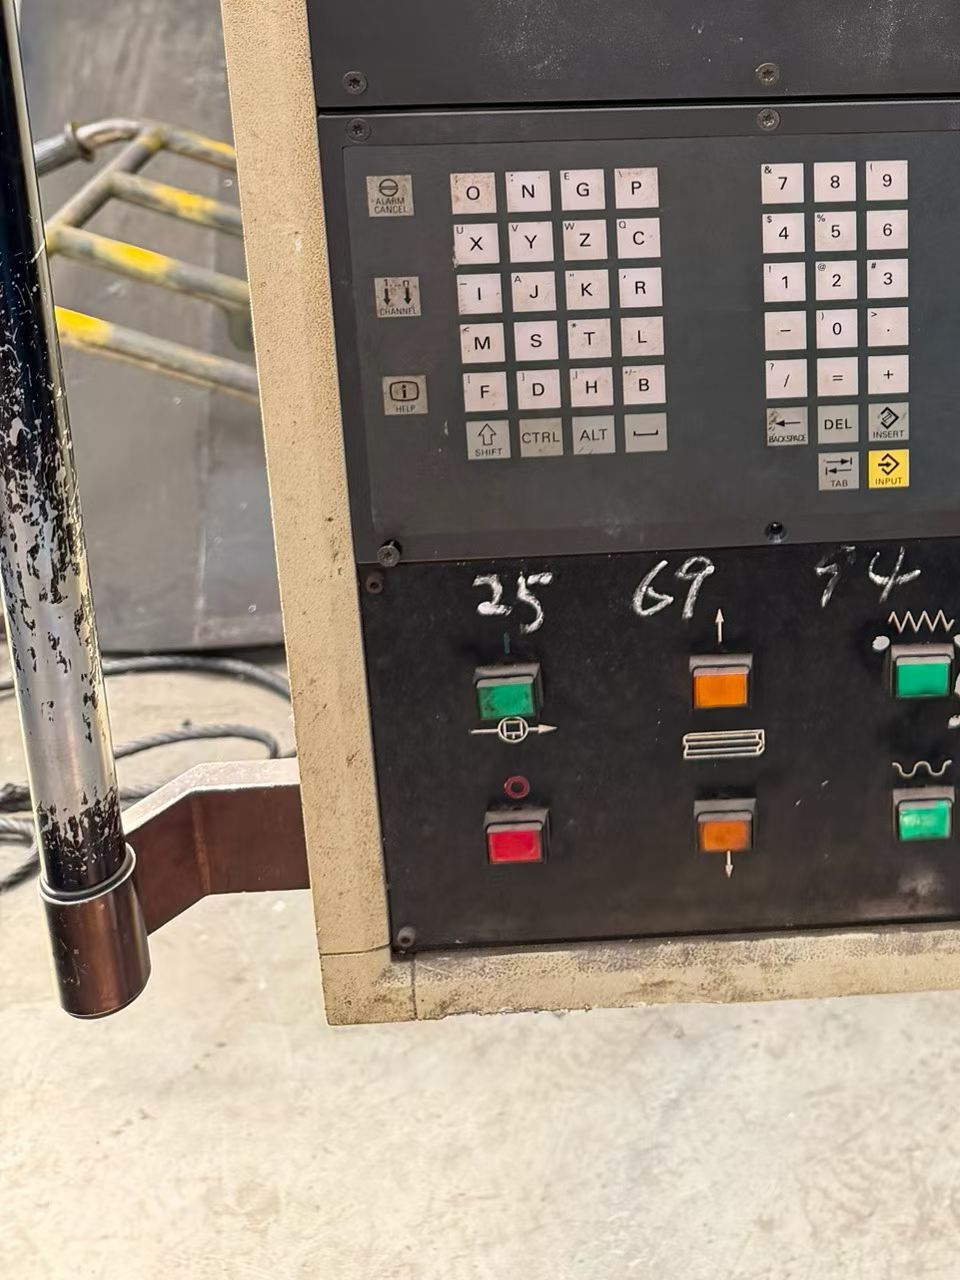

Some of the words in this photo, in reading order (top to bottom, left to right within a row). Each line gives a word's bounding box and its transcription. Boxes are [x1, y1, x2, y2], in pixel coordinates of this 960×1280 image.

[564, 172, 570, 180] E
[764, 165, 773, 174] &
[631, 181, 642, 195] P
[777, 176, 788, 190] 7
[830, 175, 840, 189] 8
[882, 174, 892, 188] 9
[466, 185, 480, 200] O
[522, 184, 535, 198] N
[576, 182, 590, 197] G
[375, 197, 405, 206] ALARM
[374, 205, 407, 214] CANCEL
[618, 220, 627, 229] Q
[766, 215, 773, 224] $
[816, 214, 826, 223] %
[456, 226, 464, 234] U
[511, 224, 519, 233] V
[564, 222, 575, 231] W
[778, 226, 789, 240] 4
[831, 224, 841, 239] 5
[882, 223, 893, 237] 6
[470, 236, 484, 251] X
[524, 235, 537, 249] Y
[579, 233, 591, 247] Z
[632, 231, 645, 245] C
[817, 263, 827, 272] @
[514, 275, 522, 283] A
[781, 275, 788, 289] 1
[831, 273, 842, 287] 2
[883, 272, 893, 285] 3
[477, 287, 482, 301] I
[529, 285, 539, 299] J
[581, 283, 593, 297] K
[635, 281, 646, 294] R
[379, 306, 417, 316] CHANNEL
[832, 322, 842, 335] 0
[474, 336, 491, 350] M
[530, 334, 542, 348] S
[583, 331, 596, 345] T
[638, 330, 647, 344] L
[480, 385, 490, 399] F
[532, 383, 545, 396] D
[586, 380, 598, 394] H
[638, 378, 650, 392] B
[395, 404, 416, 413] HELP
[824, 419, 853, 430] DEL
[521, 431, 561, 444] CTRL
[579, 428, 608, 441] ALT
[768, 435, 806, 443] BACKSPACE
[872, 430, 905, 439] INSERT
[475, 447, 503, 457] SHIFT
[830, 479, 848, 488] TAB
[875, 476, 903, 486] INPUT
[473, 570, 554, 635] 25
[632, 556, 716, 620] 69
